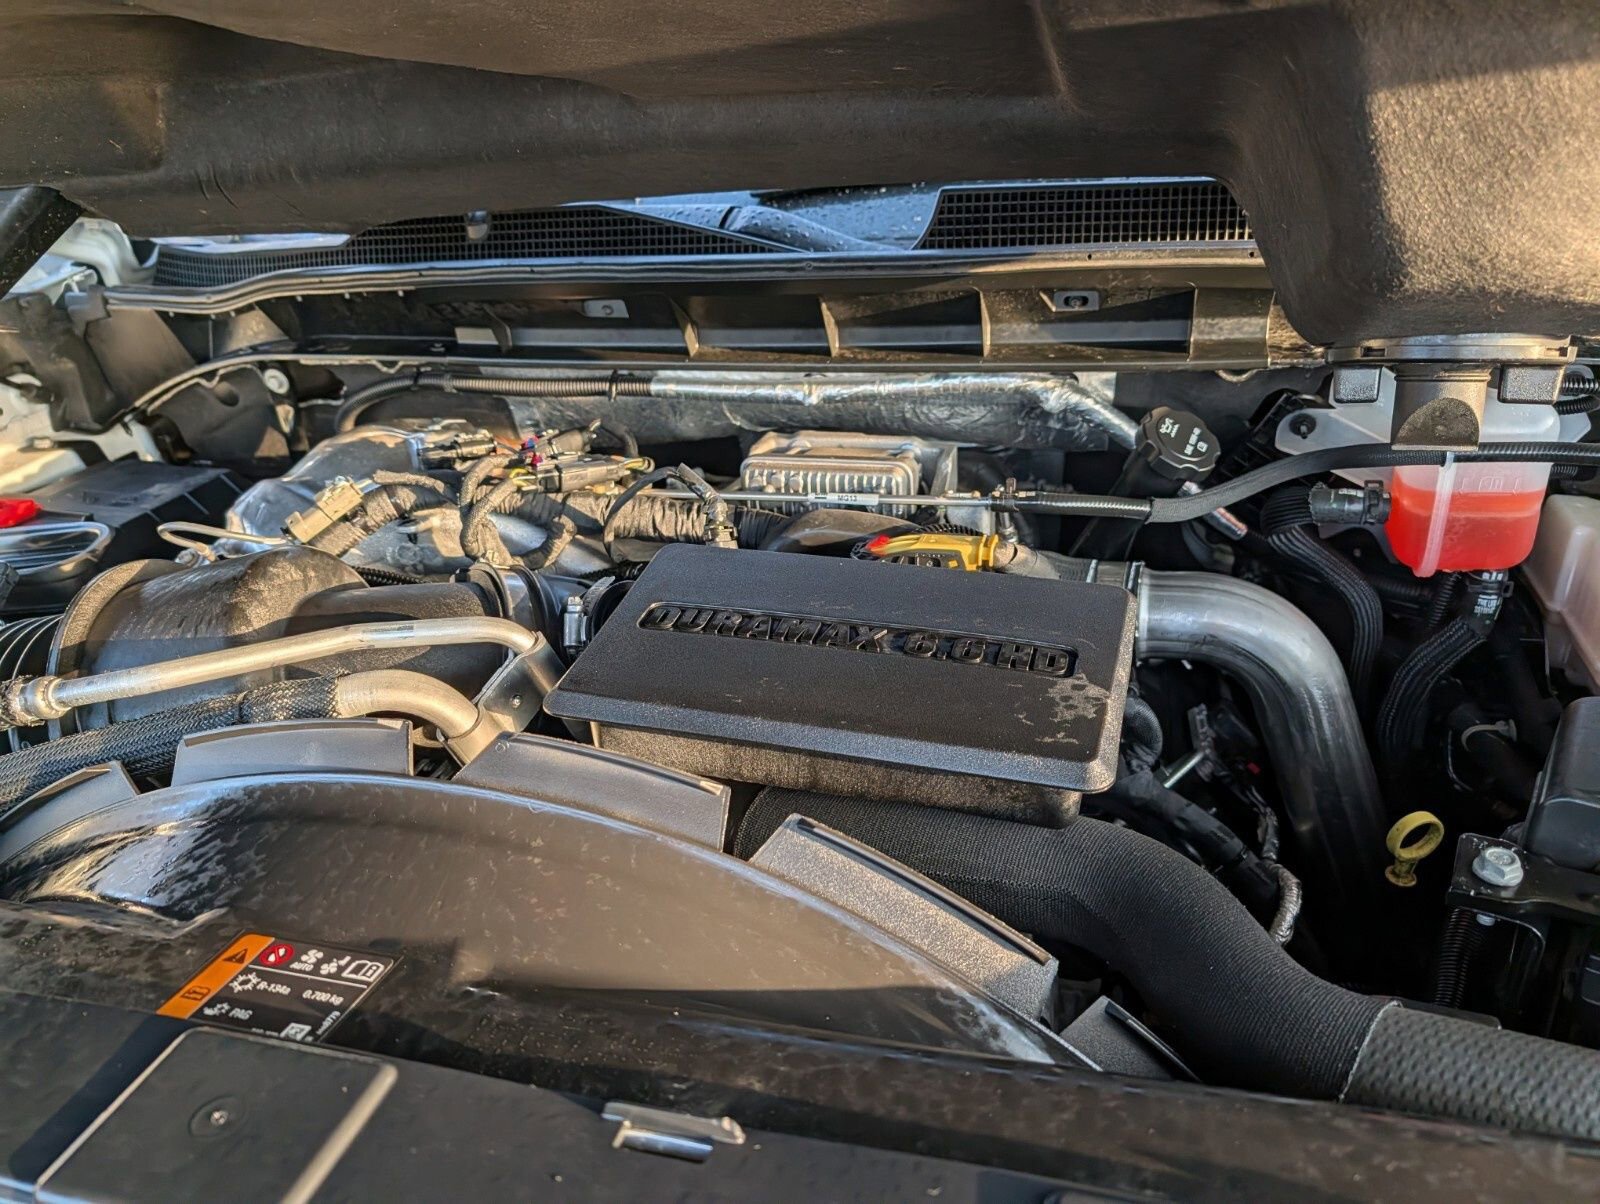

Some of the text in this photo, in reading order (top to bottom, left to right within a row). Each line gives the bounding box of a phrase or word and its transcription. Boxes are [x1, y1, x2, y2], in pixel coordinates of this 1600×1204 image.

[639, 605, 1071, 677] DURAMAX 6.6 HD
[289, 961, 315, 972] AUTO
[256, 981, 292, 996] R-134a
[302, 989, 331, 1002] 0.700
[228, 1007, 253, 1020] PAG
